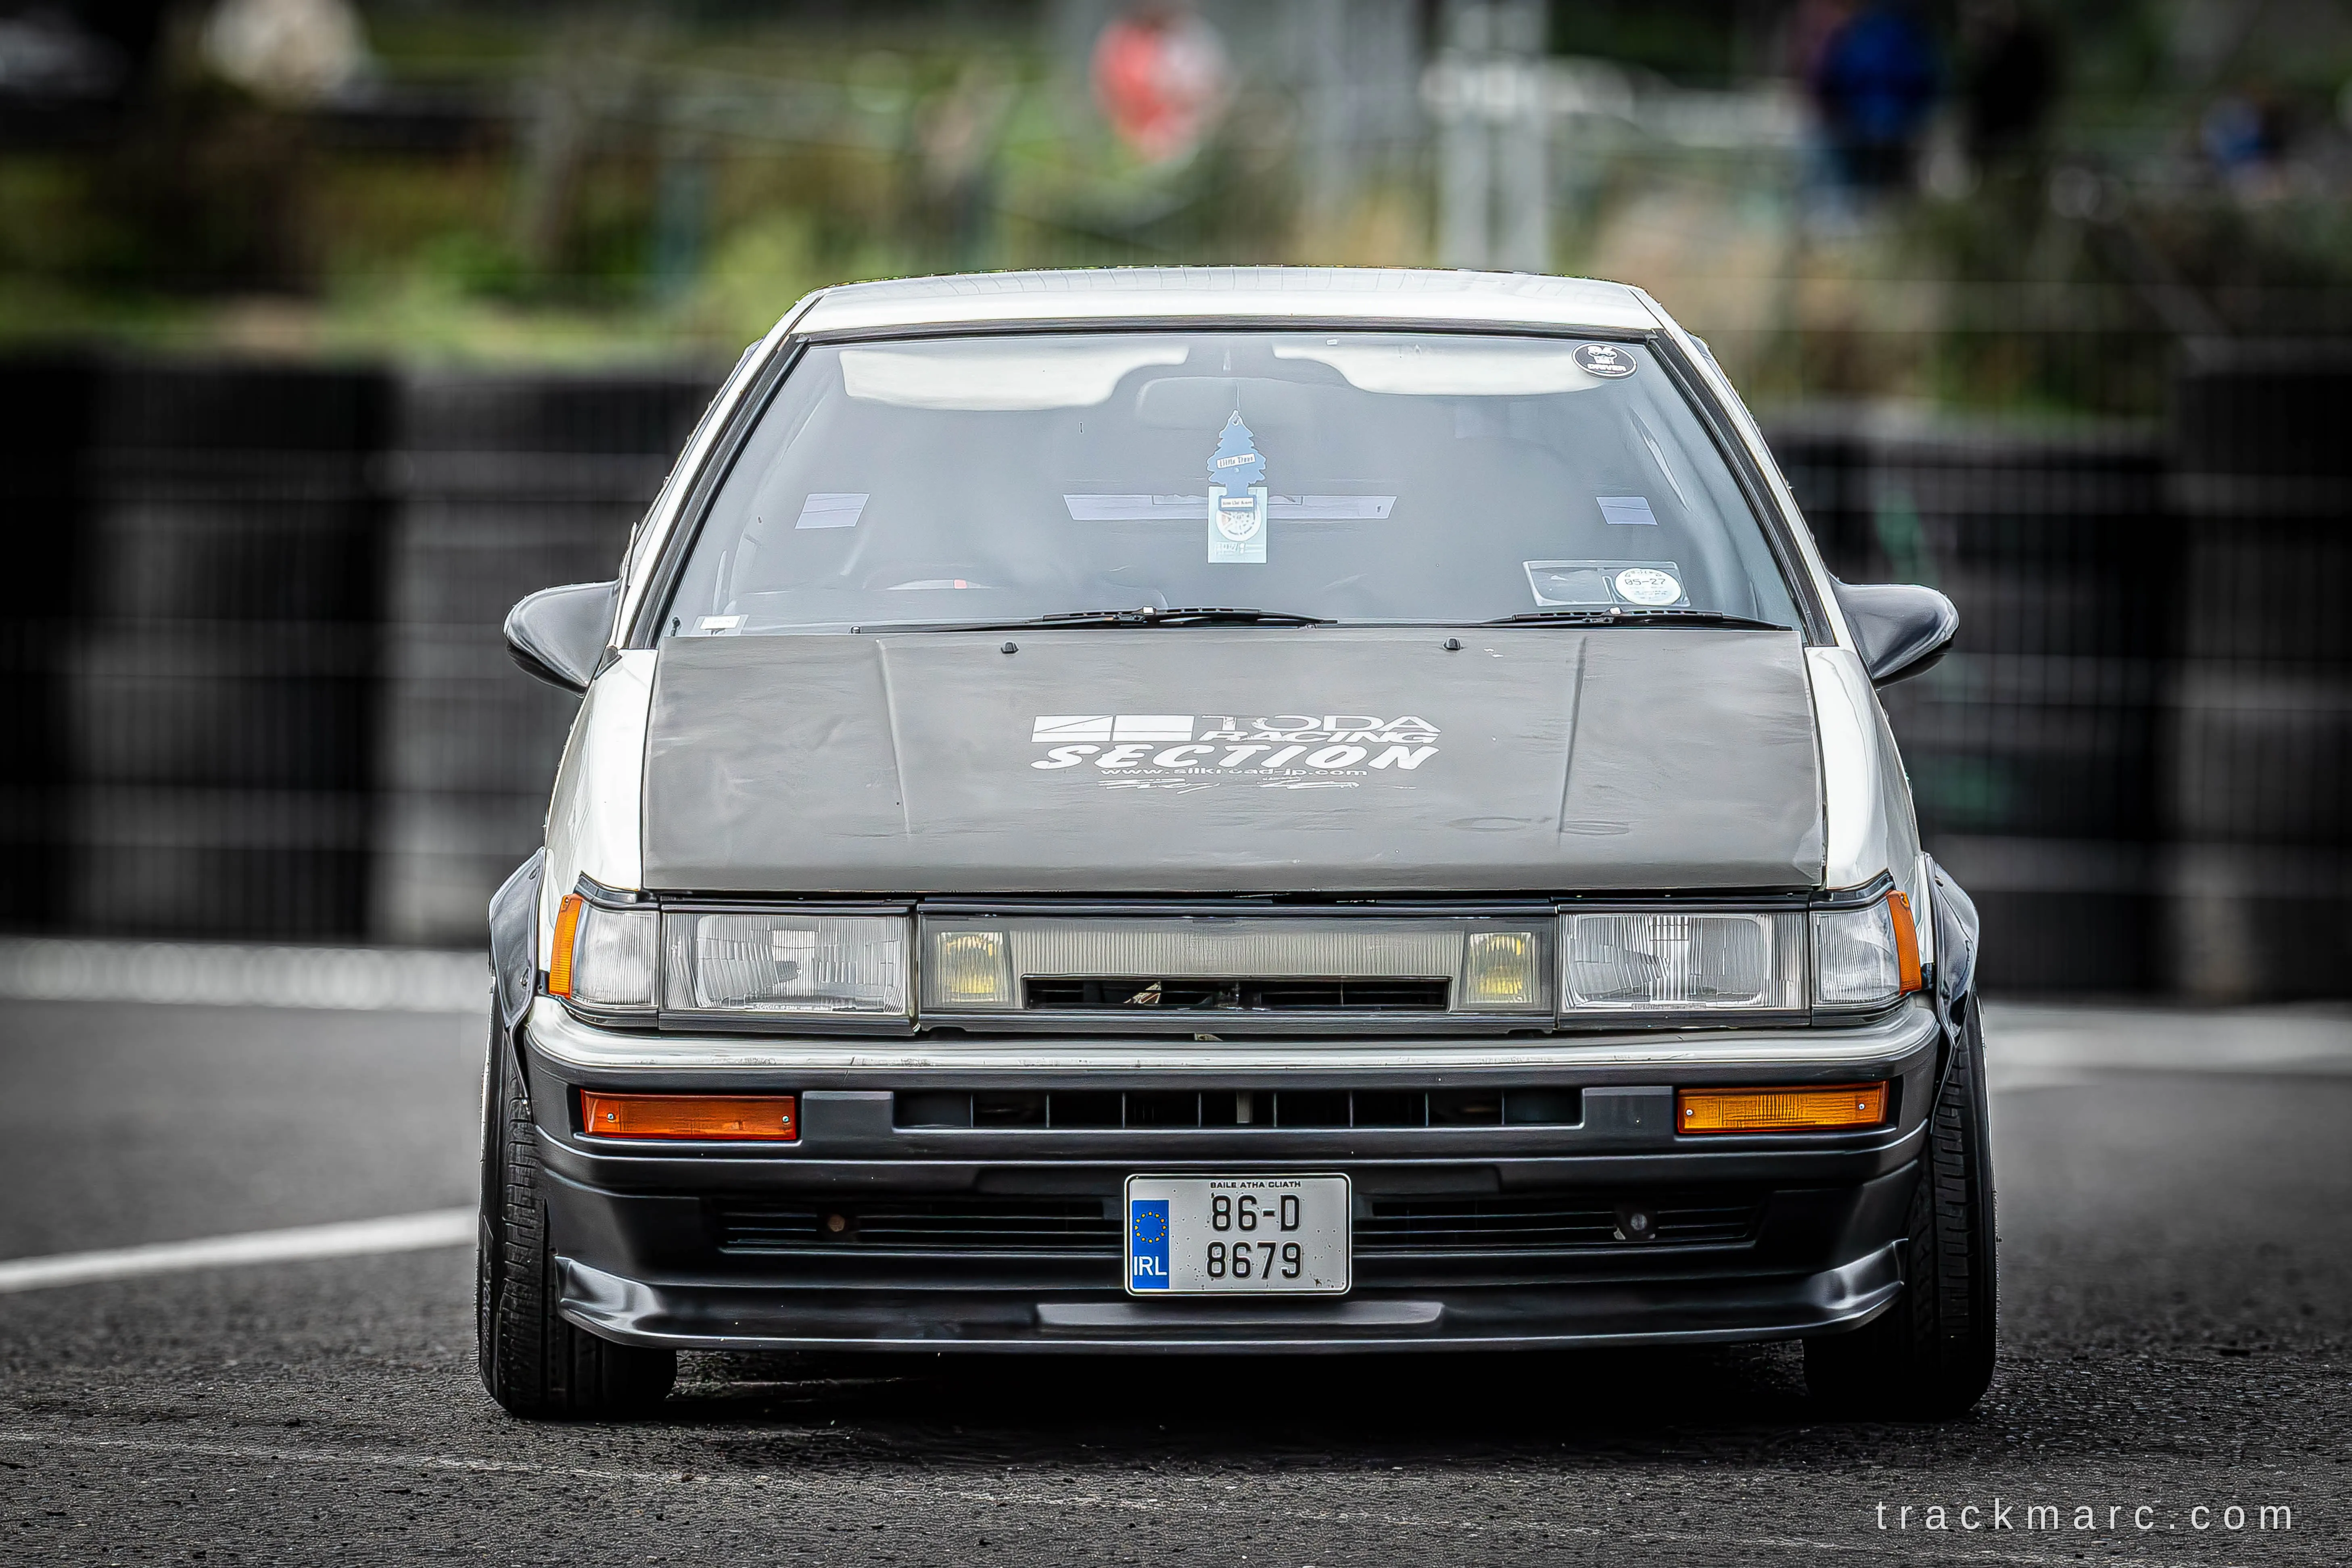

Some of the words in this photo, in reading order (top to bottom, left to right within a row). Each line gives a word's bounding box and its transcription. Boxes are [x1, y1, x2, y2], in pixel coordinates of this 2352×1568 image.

[1201, 714, 1441, 732] TODA
[1198, 731, 1441, 744] RACING
[1031, 744, 1439, 770] SECTION
[1212, 1195, 1300, 1232] 86-D
[1134, 1256, 1167, 1276] IRL
[1207, 1242, 1301, 1279] 8679
